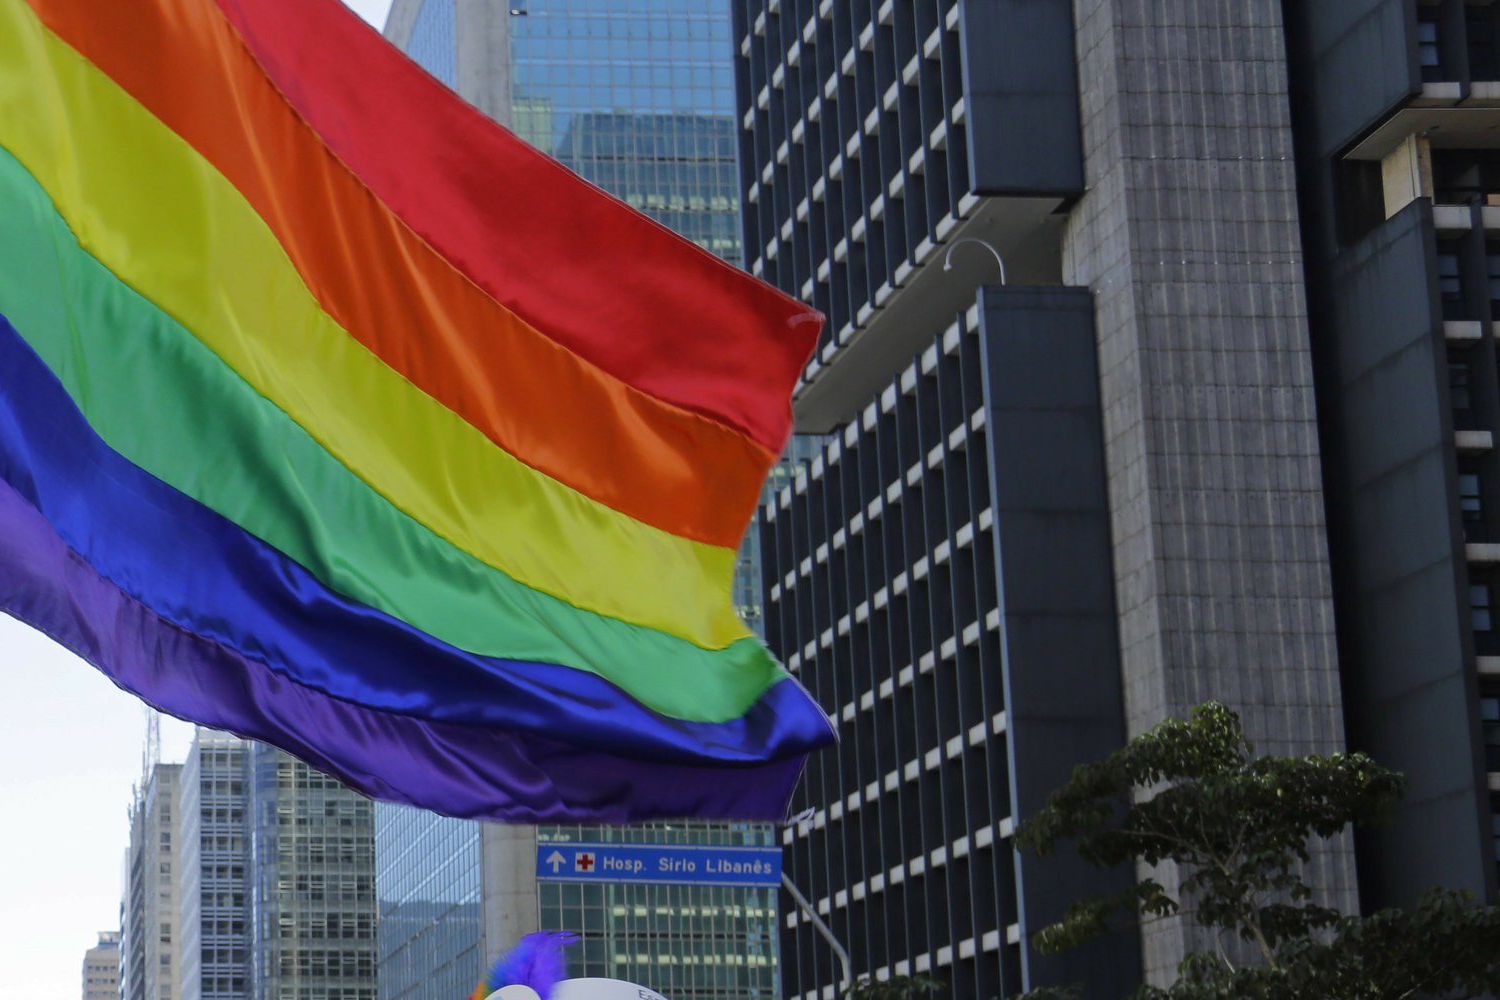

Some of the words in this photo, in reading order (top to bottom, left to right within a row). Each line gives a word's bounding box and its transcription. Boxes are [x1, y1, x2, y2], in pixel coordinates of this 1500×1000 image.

[603, 856, 647, 873] Hosp.
[659, 856, 696, 873] Sírio
[705, 858, 772, 875] Libanês
